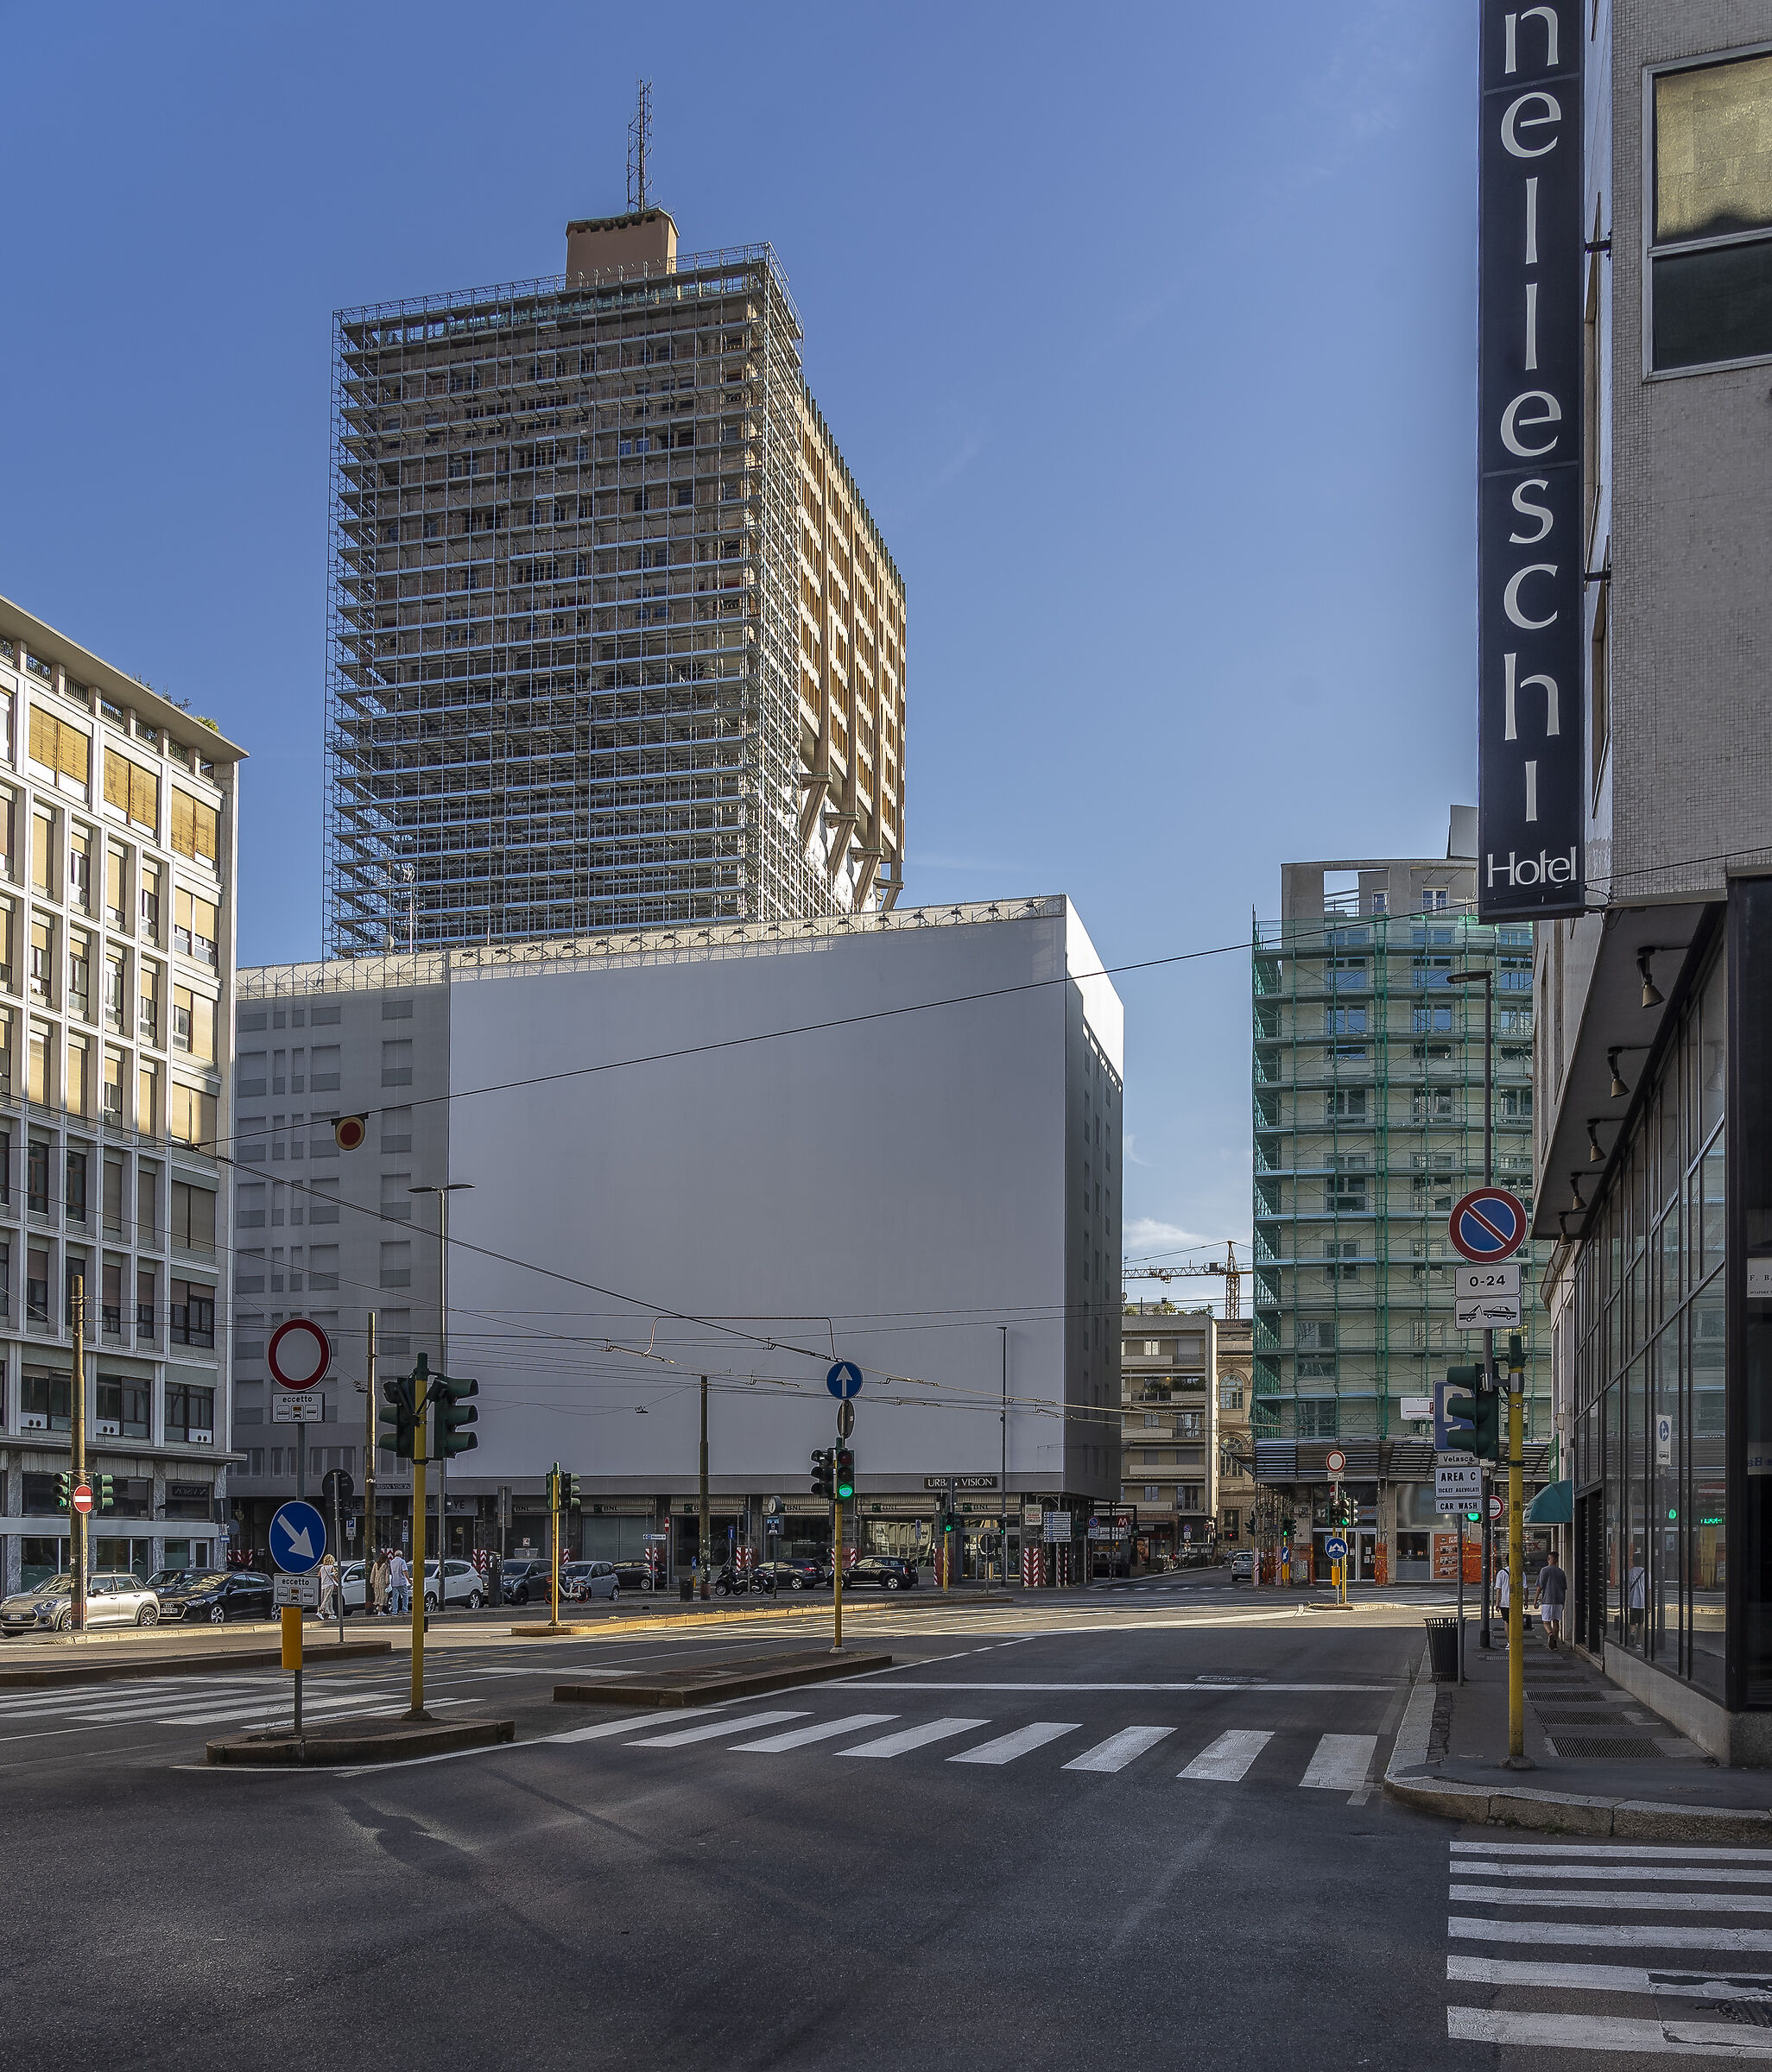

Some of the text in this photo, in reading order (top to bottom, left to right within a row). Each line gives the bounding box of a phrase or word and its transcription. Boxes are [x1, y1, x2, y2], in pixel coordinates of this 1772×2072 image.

[1487, 846, 1577, 888] Hotel
[1469, 1274, 1506, 1287] 0-24
[1440, 1471, 1477, 1481] AREA C
[927, 1477, 993, 1487] URB VISION
